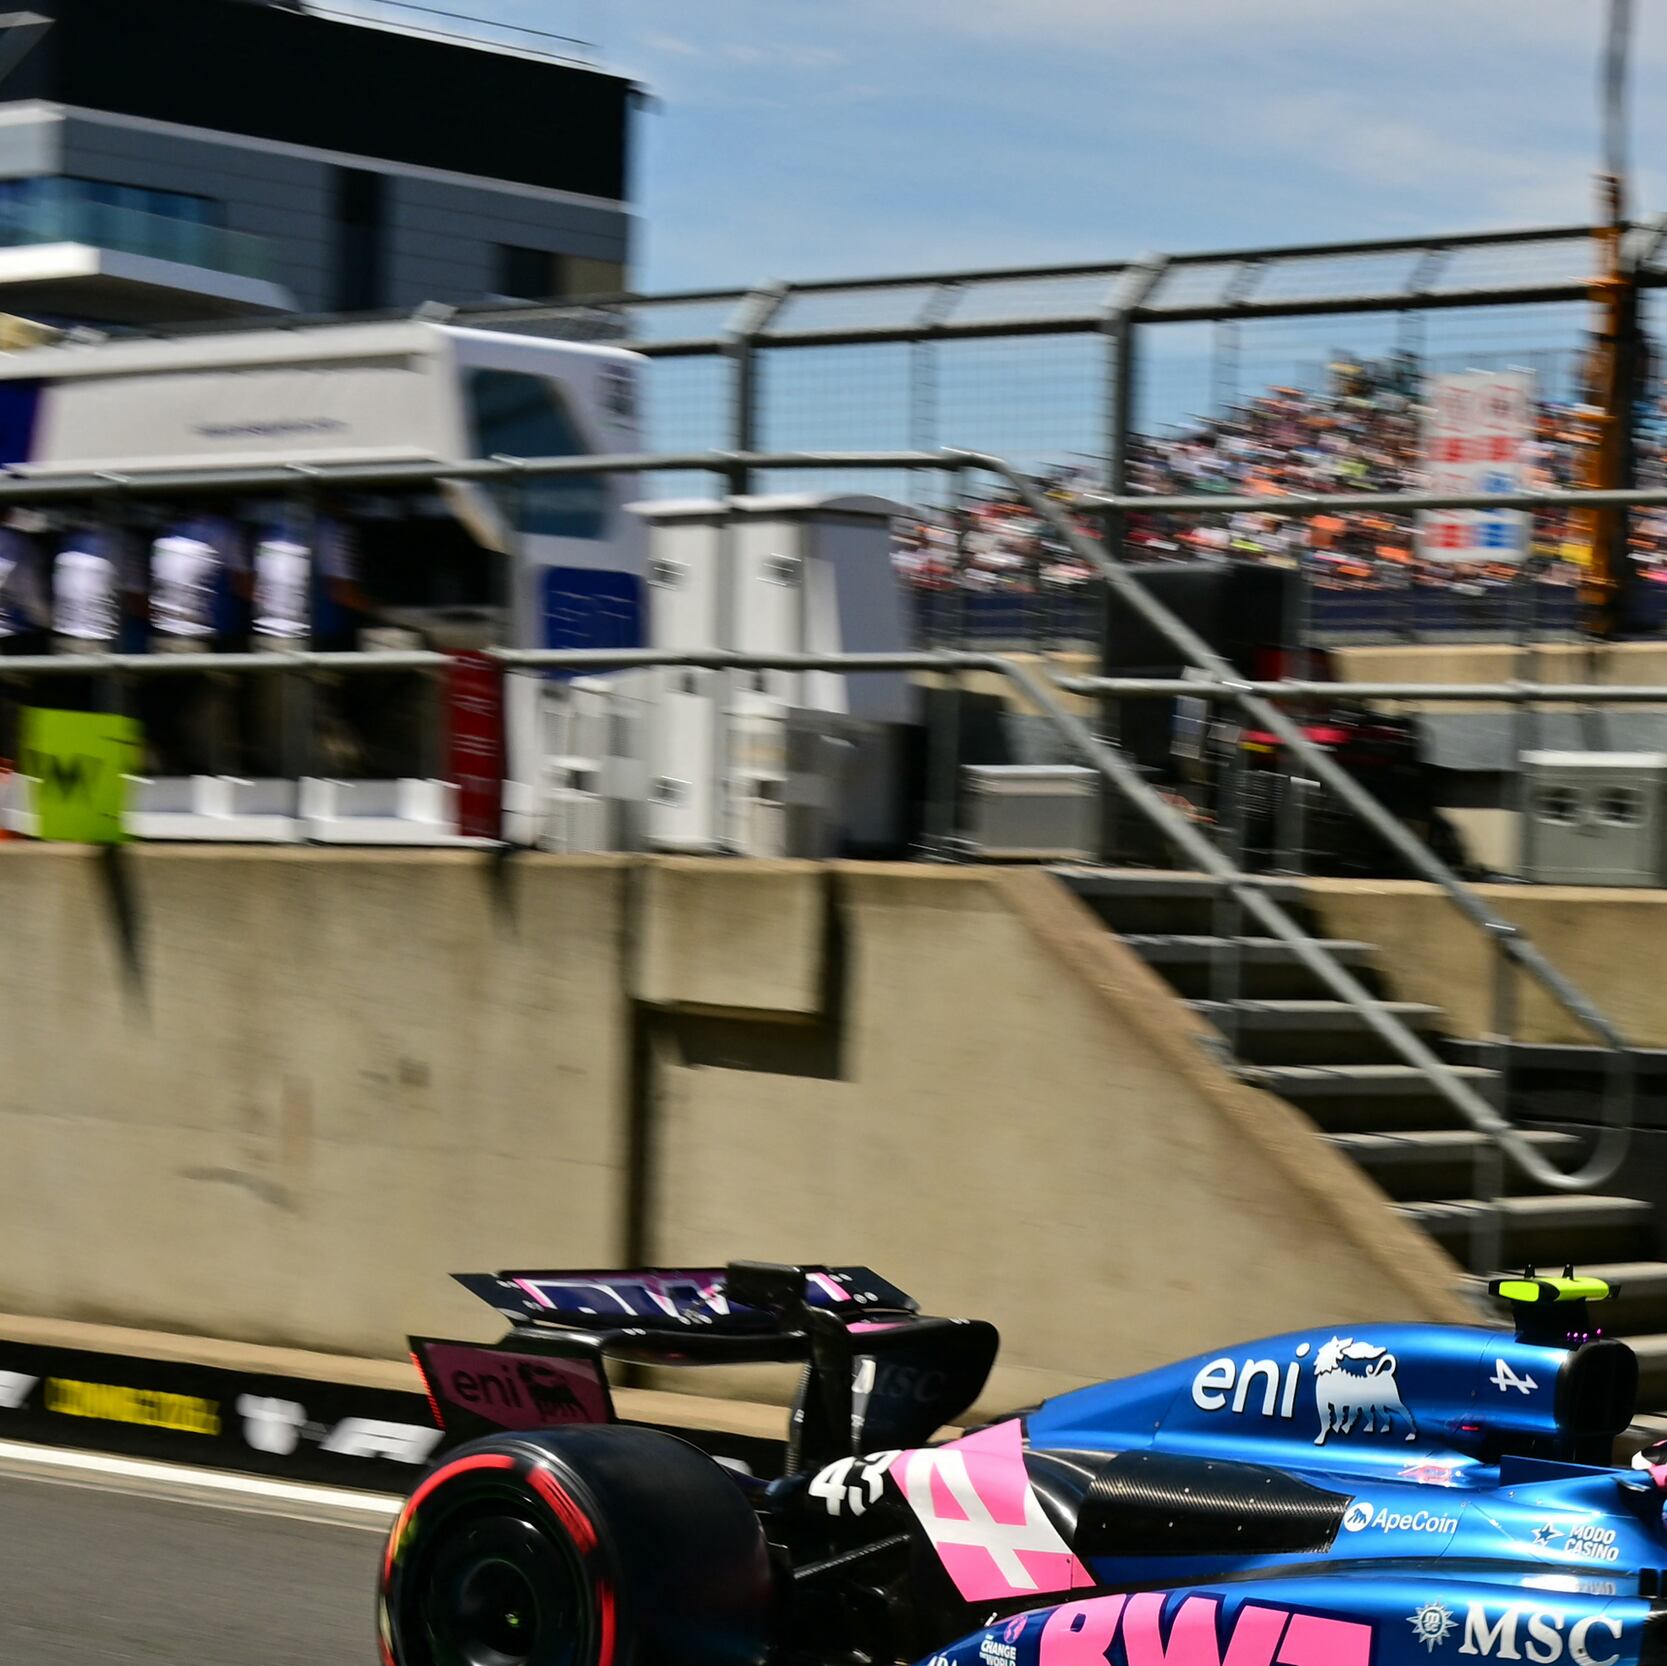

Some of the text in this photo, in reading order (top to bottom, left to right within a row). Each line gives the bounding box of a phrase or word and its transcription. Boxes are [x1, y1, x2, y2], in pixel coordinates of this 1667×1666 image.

[453, 1365, 519, 1407] eni
[1190, 1342, 1310, 1419] eni
[809, 1450, 902, 1517] 43
[1372, 1506, 1458, 1534] ApeCoin
[1569, 1524, 1616, 1545] MODO
[1564, 1538, 1619, 1561] CASINO
[981, 1640, 1016, 1660] CHANGE
